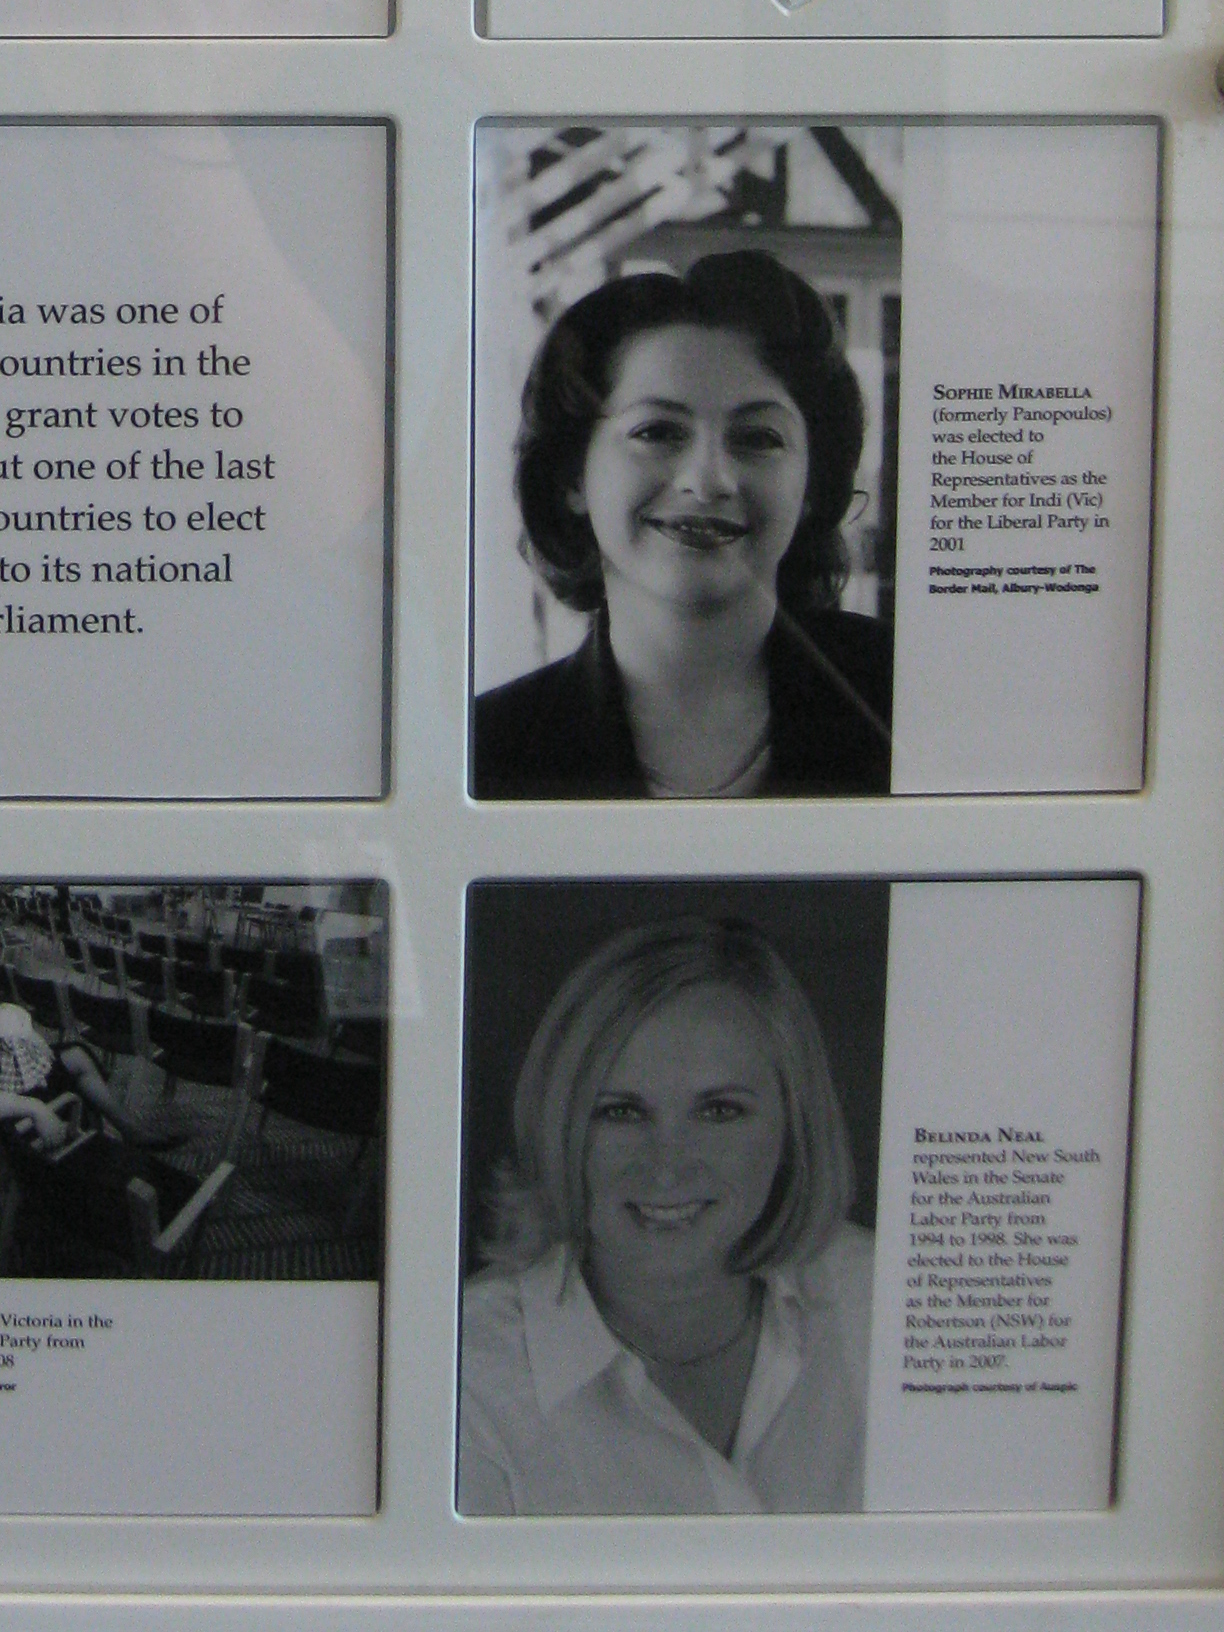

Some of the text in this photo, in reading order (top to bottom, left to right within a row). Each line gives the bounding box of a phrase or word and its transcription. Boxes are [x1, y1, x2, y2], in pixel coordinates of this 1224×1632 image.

[37, 304, 105, 324] was
[116, 304, 178, 324] one
[190, 294, 224, 324] of
[152, 348, 186, 375] in
[197, 344, 250, 376] the
[6, 403, 97, 438] grant
[108, 403, 199, 428] votes
[210, 403, 243, 428] to
[933, 405, 1112, 426] (formerly Panopoulos)
[932, 428, 1044, 444] was elected to
[33, 460, 95, 480] one
[106, 450, 141, 480] of
[151, 448, 204, 479] the
[215, 450, 275, 479] last
[143, 506, 176, 531] to
[187, 502, 266, 531] elect
[42, 555, 81, 582] its
[92, 553, 232, 582] national
[913, 1149, 1100, 1168] represented New South
[0, 1312, 62, 1329] Victoria
[68, 1313, 83, 1328] in
[88, 1314, 113, 1329] the
